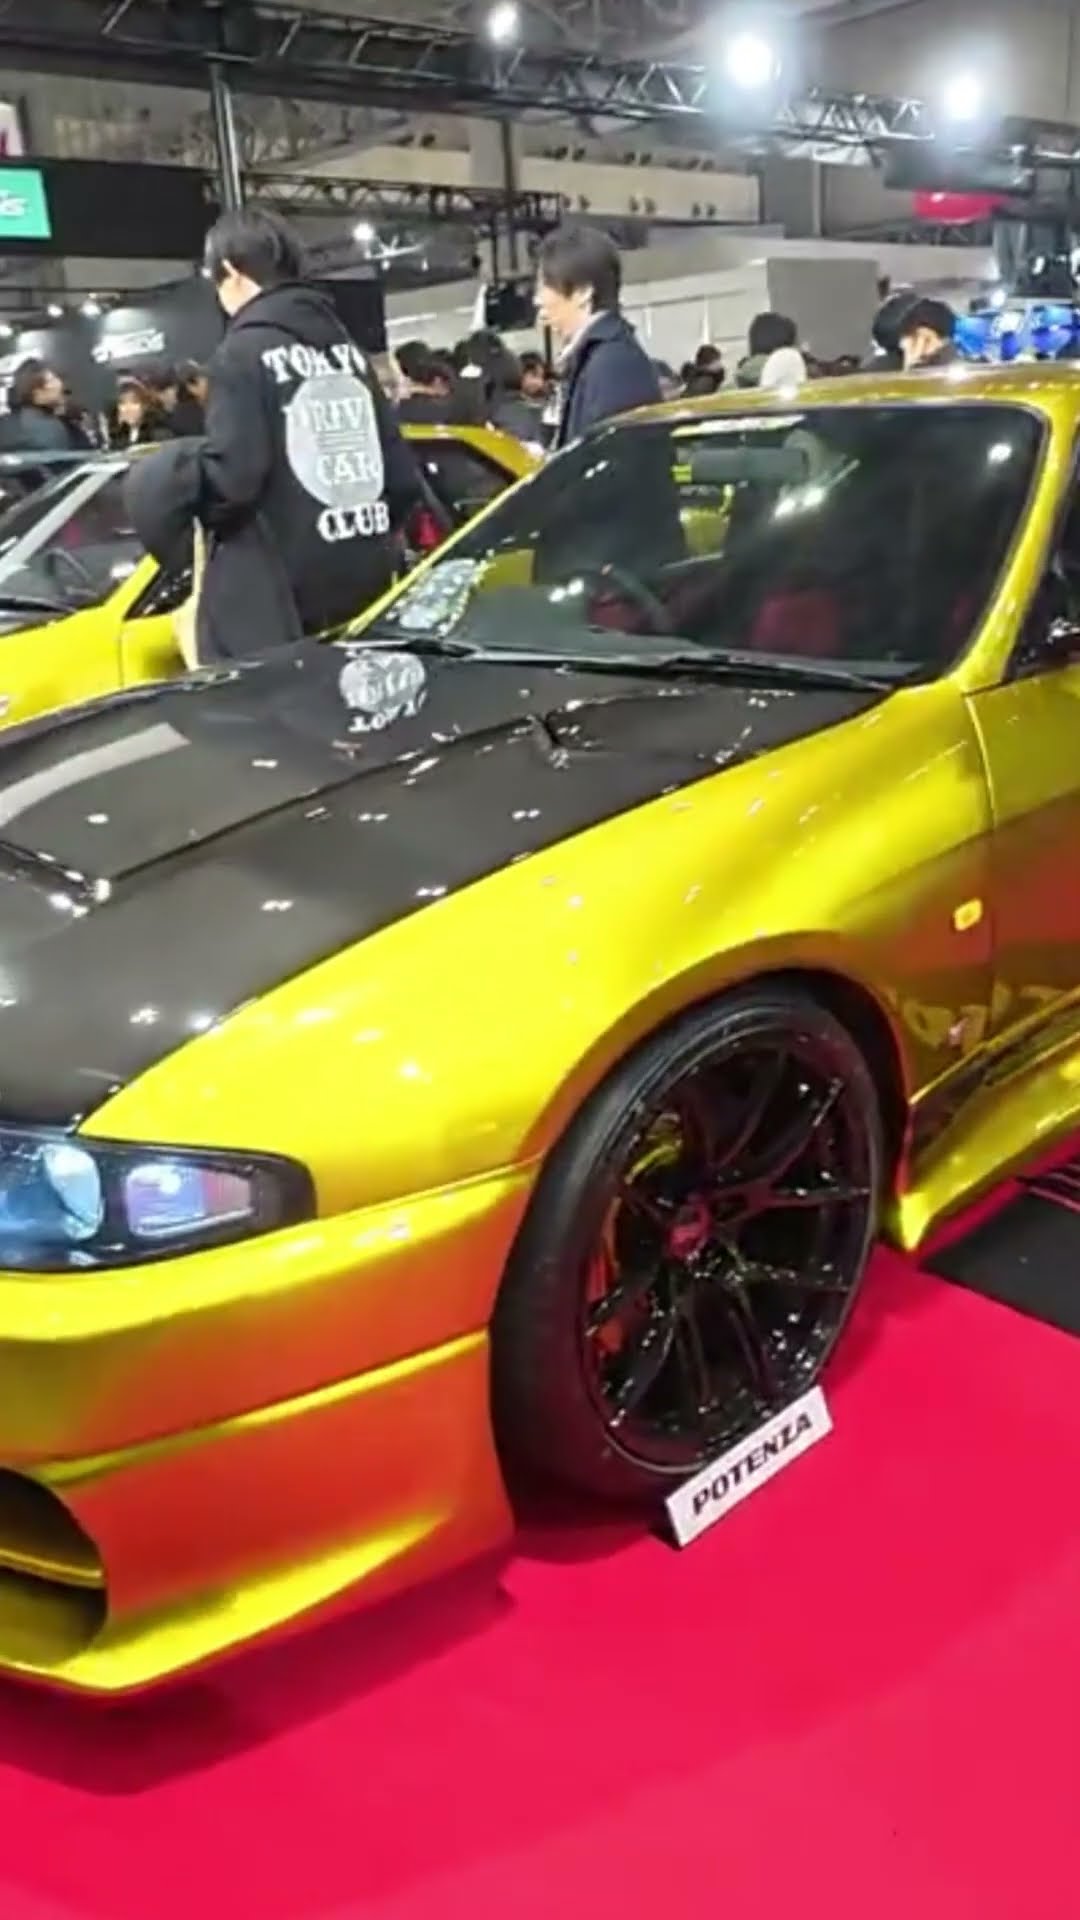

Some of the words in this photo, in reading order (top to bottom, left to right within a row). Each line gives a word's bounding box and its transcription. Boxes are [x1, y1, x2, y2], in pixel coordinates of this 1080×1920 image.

[283, 397, 373, 433] RIV
[316, 501, 390, 541] CLUB
[692, 1412, 813, 1515] POTENZA
